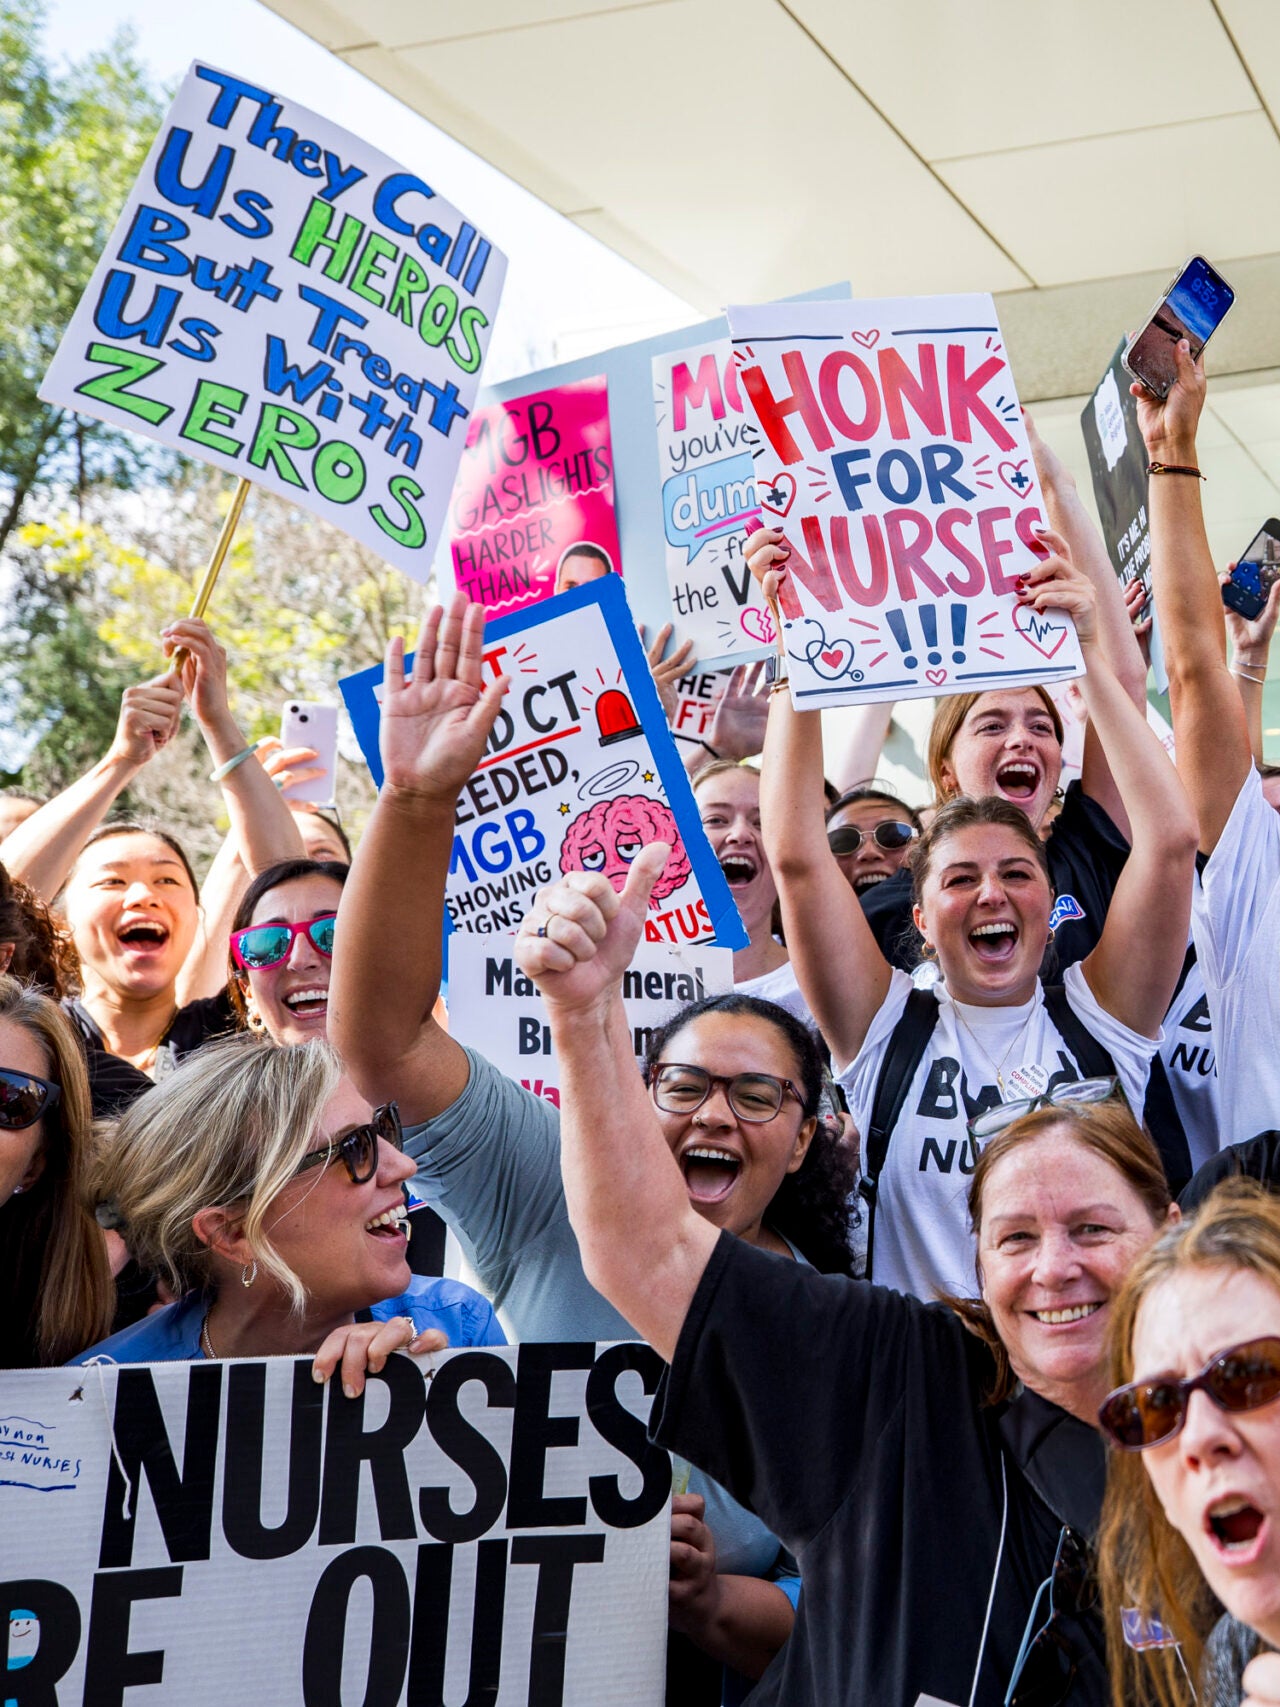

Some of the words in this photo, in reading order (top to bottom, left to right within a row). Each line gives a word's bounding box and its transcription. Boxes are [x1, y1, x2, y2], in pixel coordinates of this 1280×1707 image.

[195, 64, 367, 202] They
[372, 173, 491, 296] Call
[154, 127, 274, 239] Us
[290, 198, 489, 375] HEROS
[117, 204, 282, 313] But
[298, 284, 470, 438] Treat
[93, 269, 223, 363] Us
[263, 334, 424, 470] With
[740, 344, 1018, 466] HONK
[74, 342, 427, 551] ZEROS
[454, 446, 611, 530] GASLIGHTS
[831, 442, 977, 512] FOR
[672, 474, 761, 532] dum
[456, 518, 555, 577] HARDER
[461, 561, 531, 605] THAN
[777, 505, 1051, 619] NURSES
[672, 583, 720, 616] the
[523, 670, 580, 734] CT
[454, 748, 580, 826] EEDED,
[446, 861, 552, 921] SHOWING
[623, 966, 705, 1002] neral
[98, 1341, 673, 1568] NURSES
[302, 1533, 606, 1707] OUT
